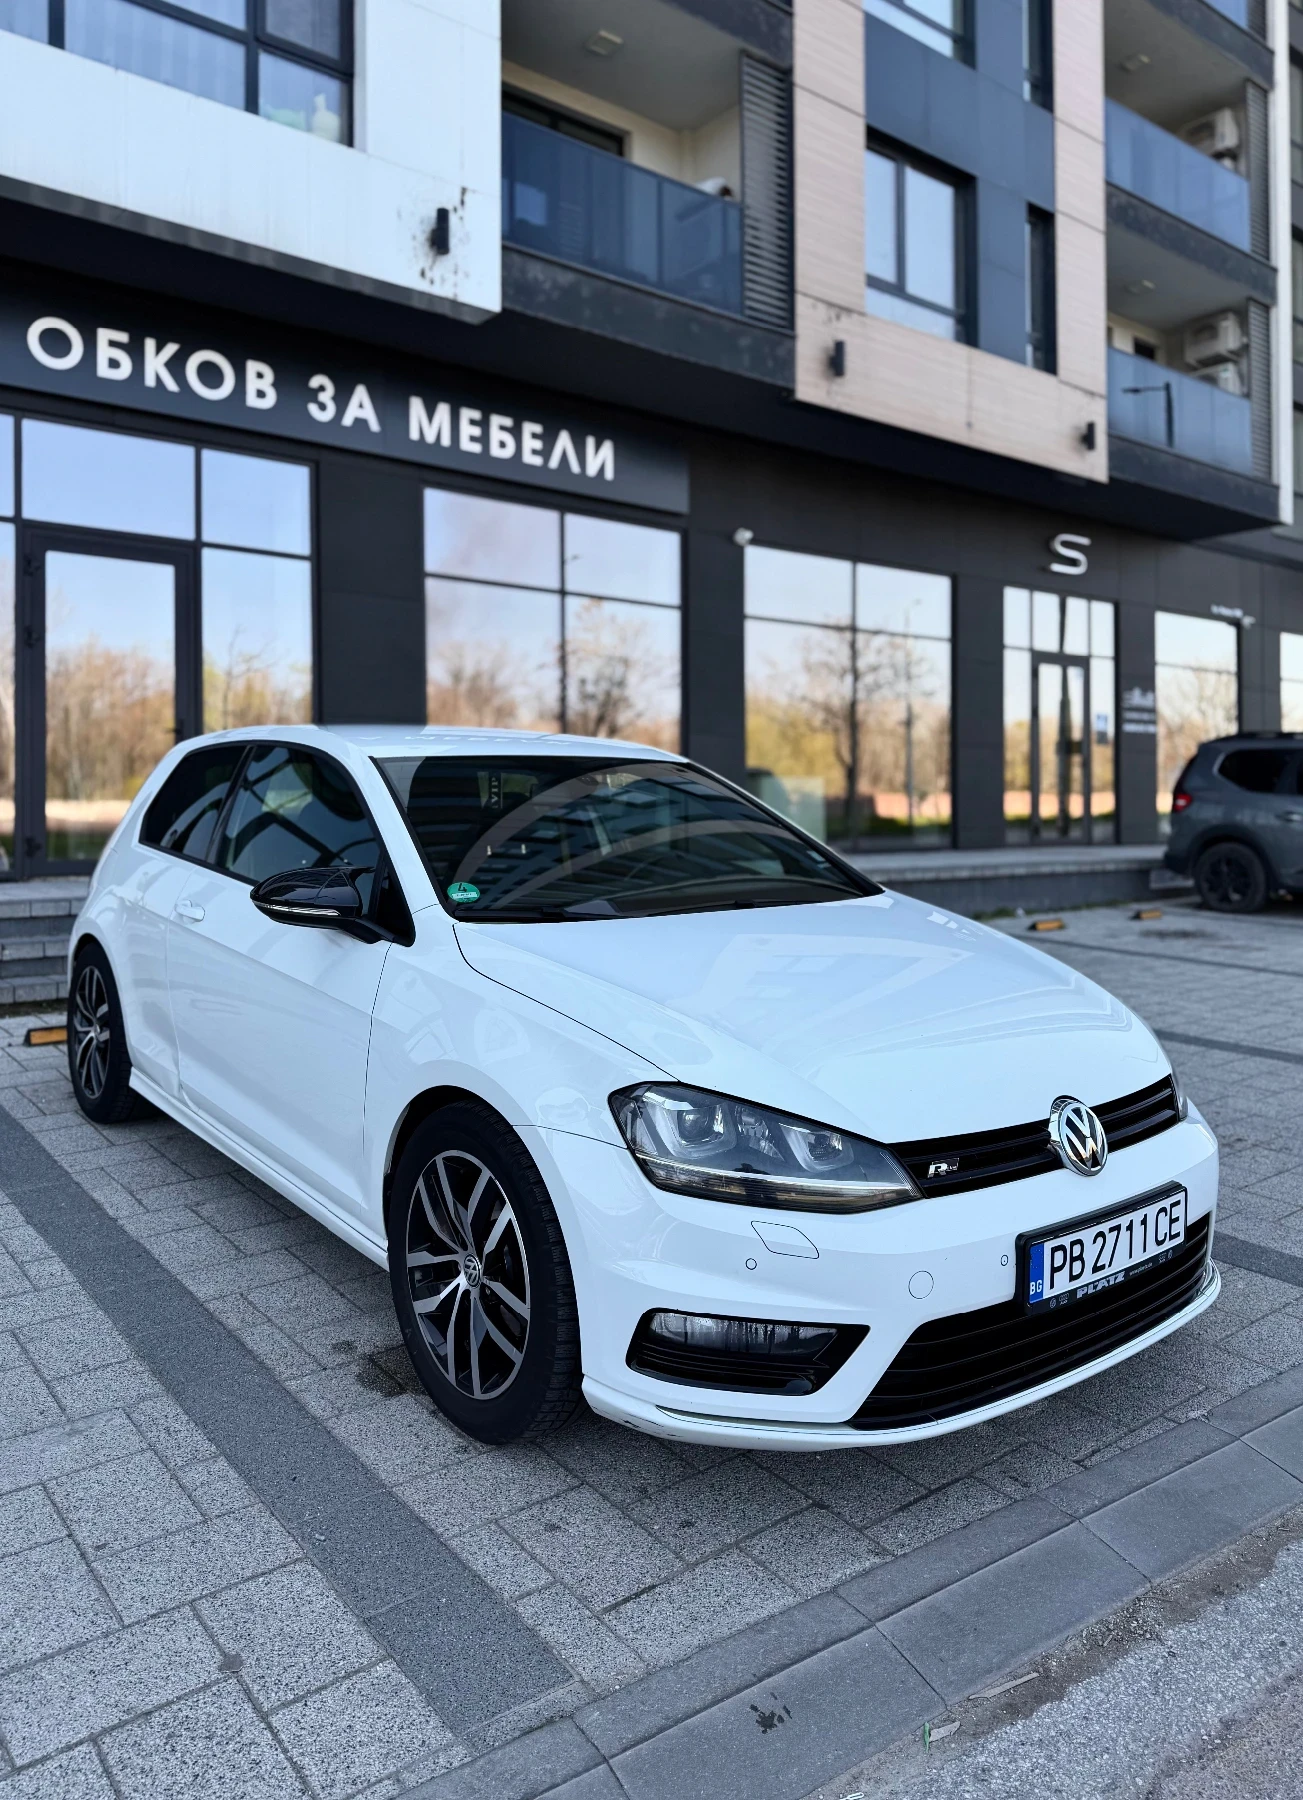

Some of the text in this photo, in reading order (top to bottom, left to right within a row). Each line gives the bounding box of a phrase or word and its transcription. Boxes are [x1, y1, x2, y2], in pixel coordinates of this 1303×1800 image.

[26, 316, 615, 481] ОБКОВ ЗА МЕБЕЛИ
[1049, 533, 1092, 575] S
[457, 882, 468, 892] 4
[1049, 1238, 1086, 1290] PB
[1029, 1279, 1043, 1295] BG
[1076, 1270, 1126, 1299] PLATZ
